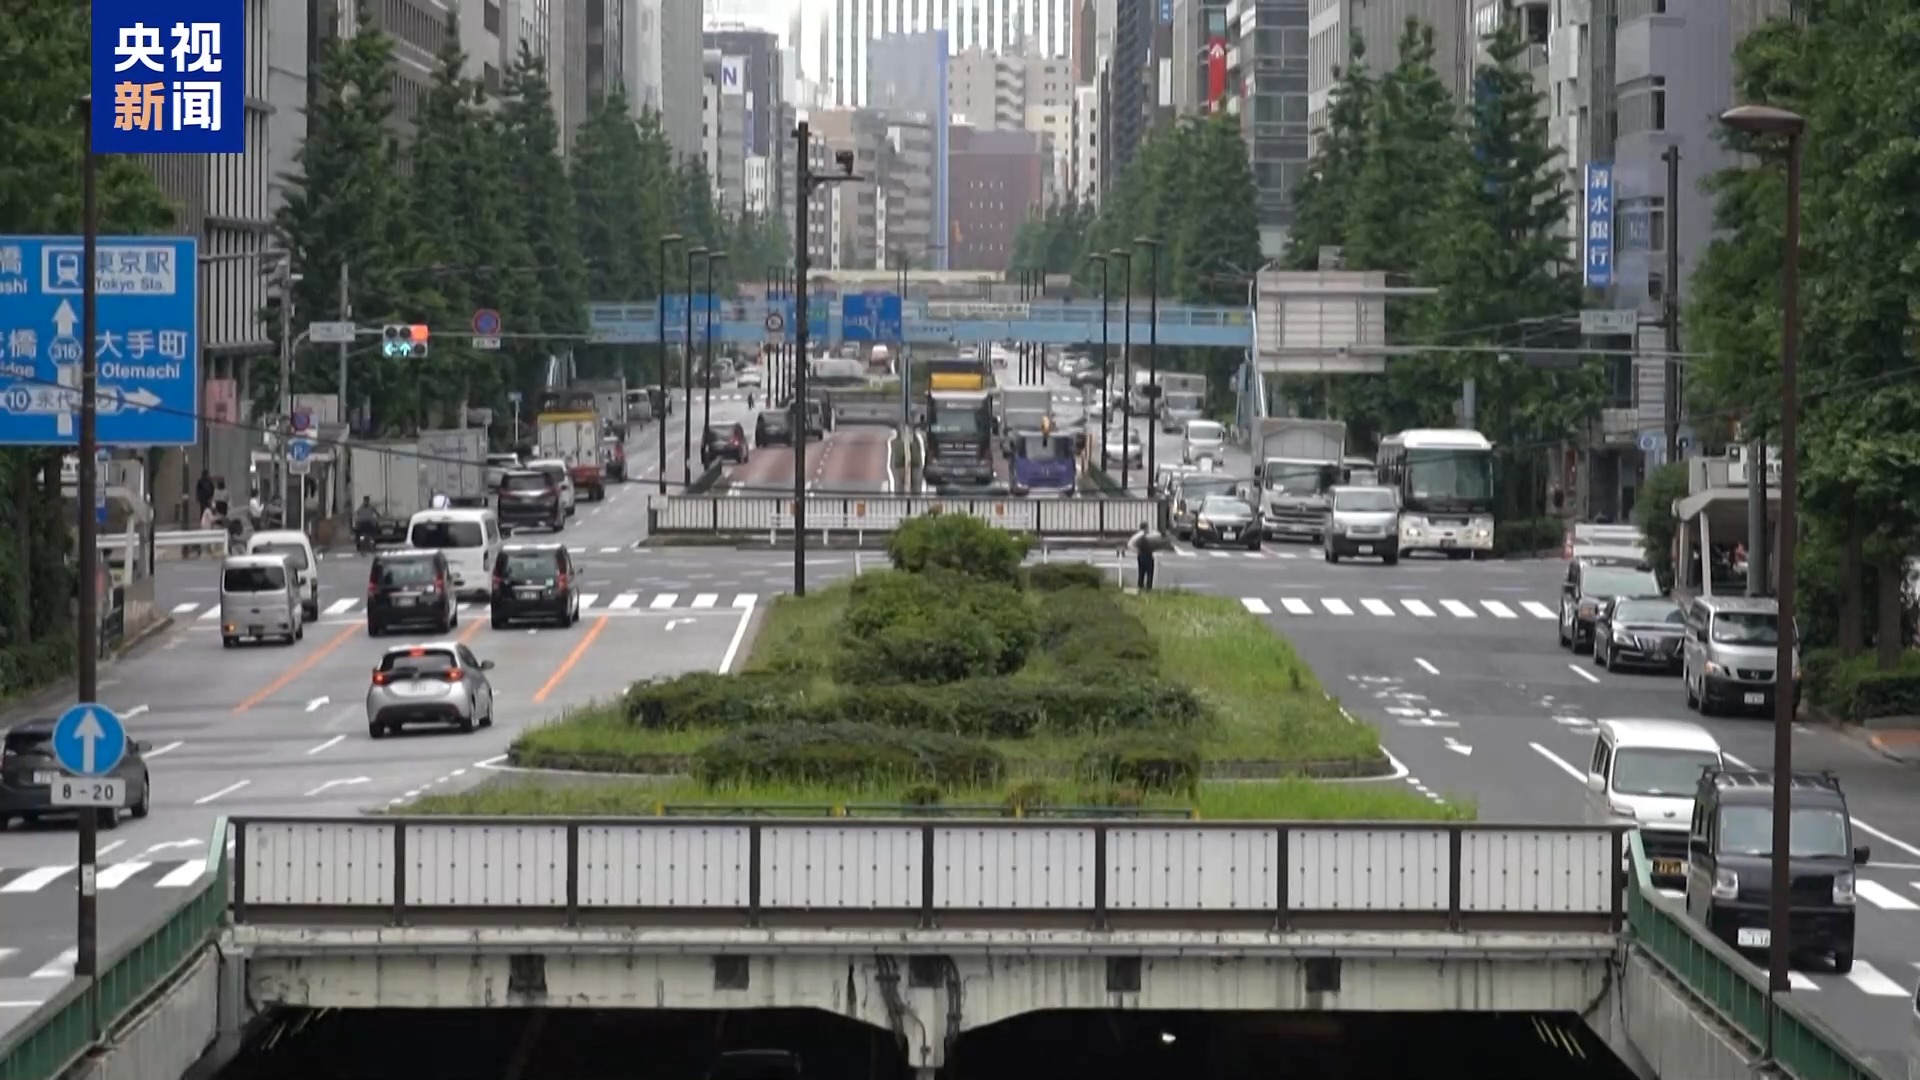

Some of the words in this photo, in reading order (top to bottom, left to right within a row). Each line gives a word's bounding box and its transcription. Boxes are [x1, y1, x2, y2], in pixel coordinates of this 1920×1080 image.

[723, 66, 737, 85] N
[1590, 169, 1608, 266] 清水銀行
[54, 343, 77, 361] 316
[95, 330, 187, 360] 大手町
[101, 362, 181, 379] Otemachi
[9, 391, 26, 408] 10
